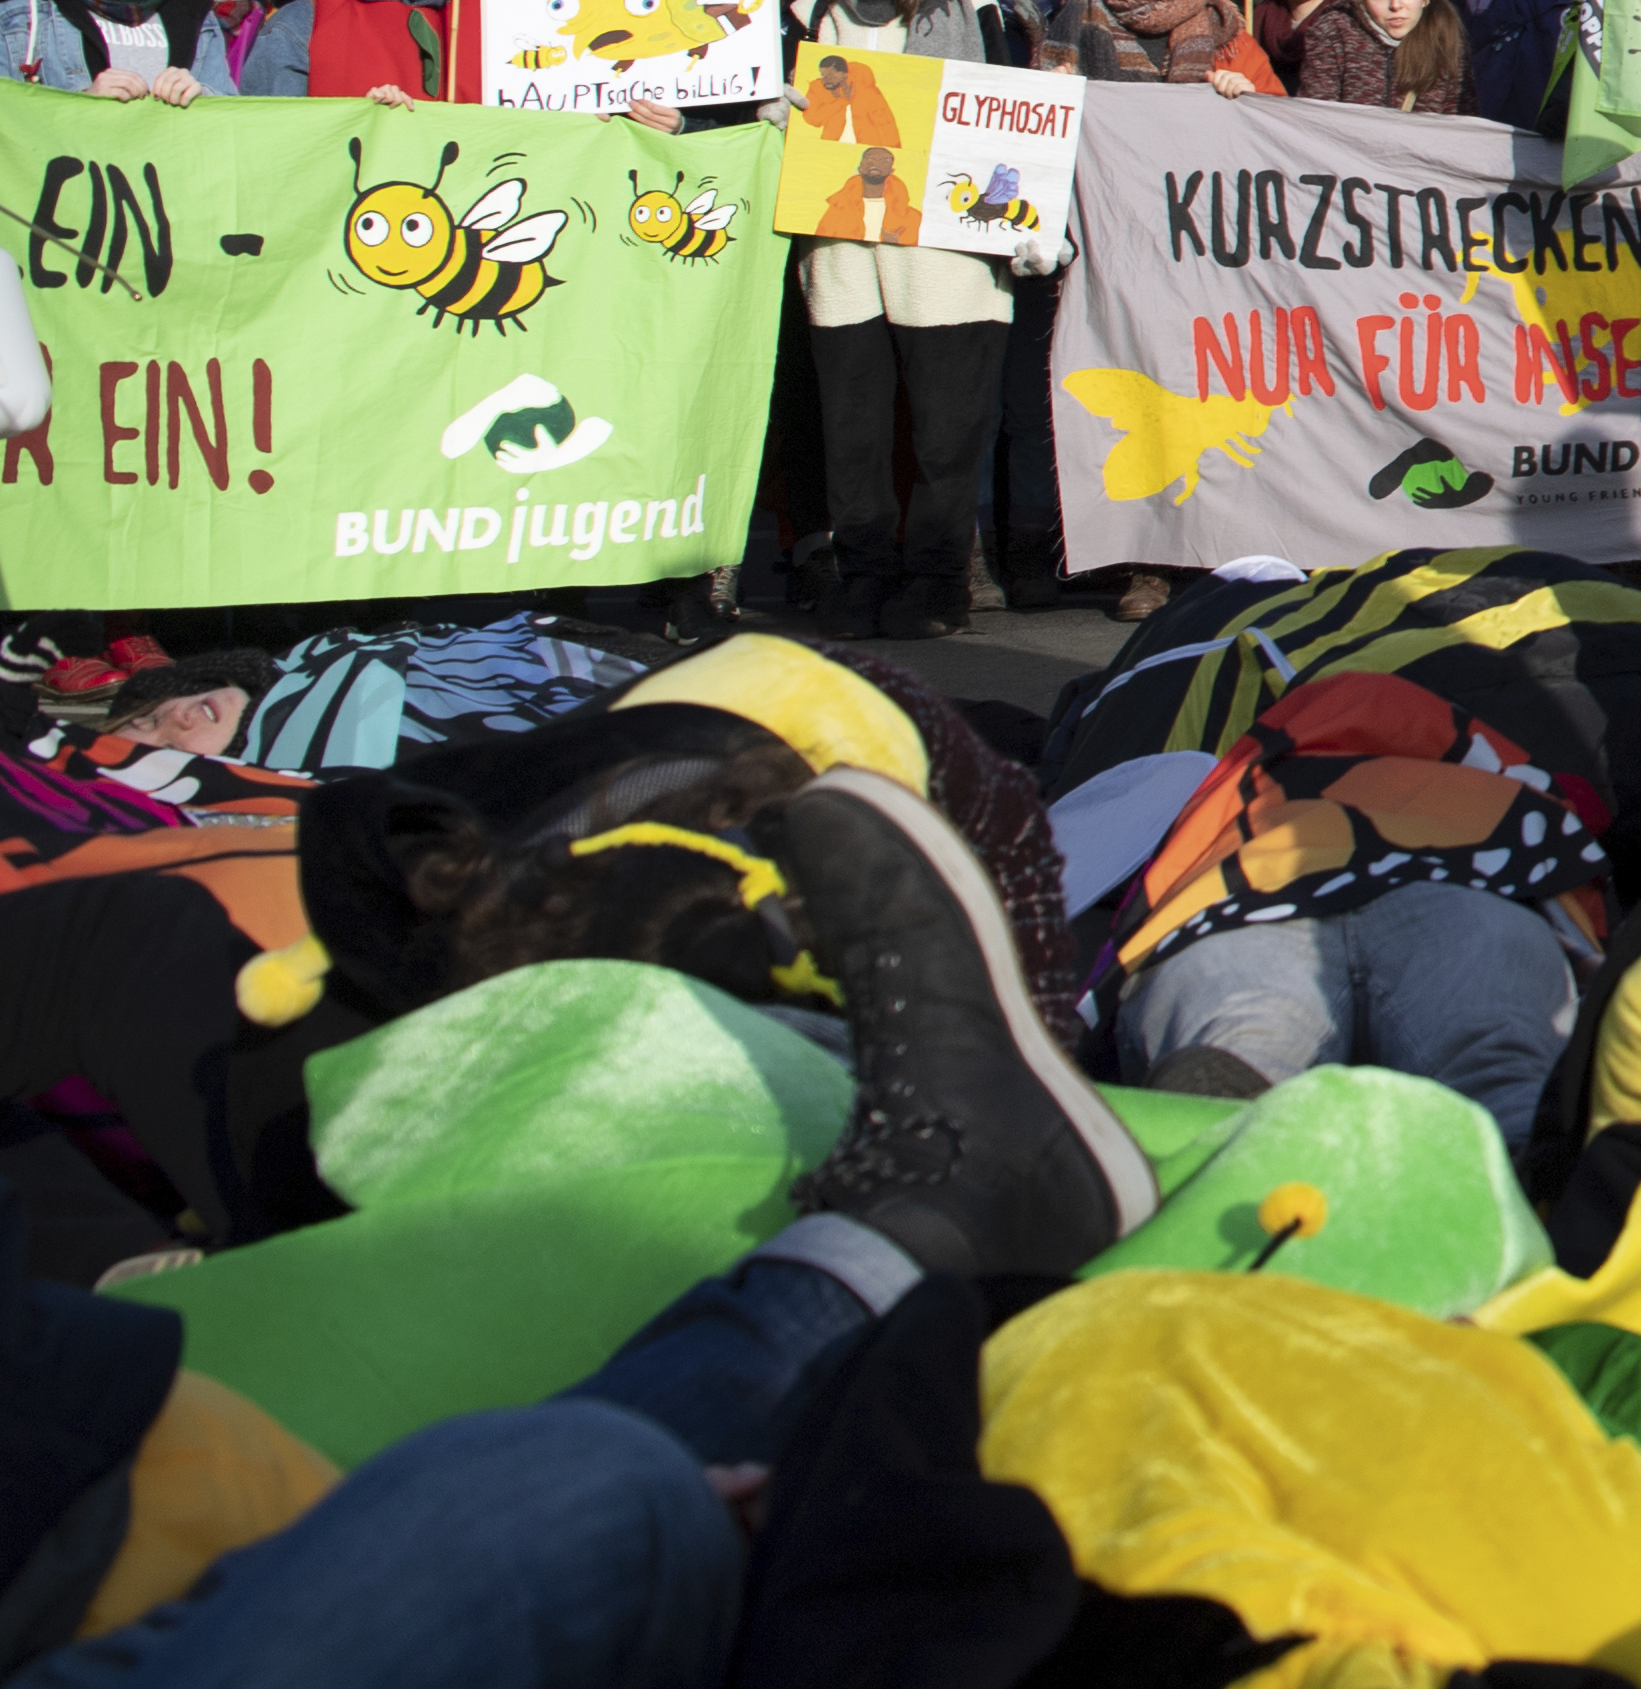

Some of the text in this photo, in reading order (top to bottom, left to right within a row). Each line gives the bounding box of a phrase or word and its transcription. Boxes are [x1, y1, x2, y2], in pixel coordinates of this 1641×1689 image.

[942, 91, 1075, 139] GLYPHOSAT
[1193, 305, 1336, 407] NUR
[1357, 292, 1487, 412] FÜR
[99, 357, 275, 496] EIN!
[1517, 491, 1580, 506] YOUNG
